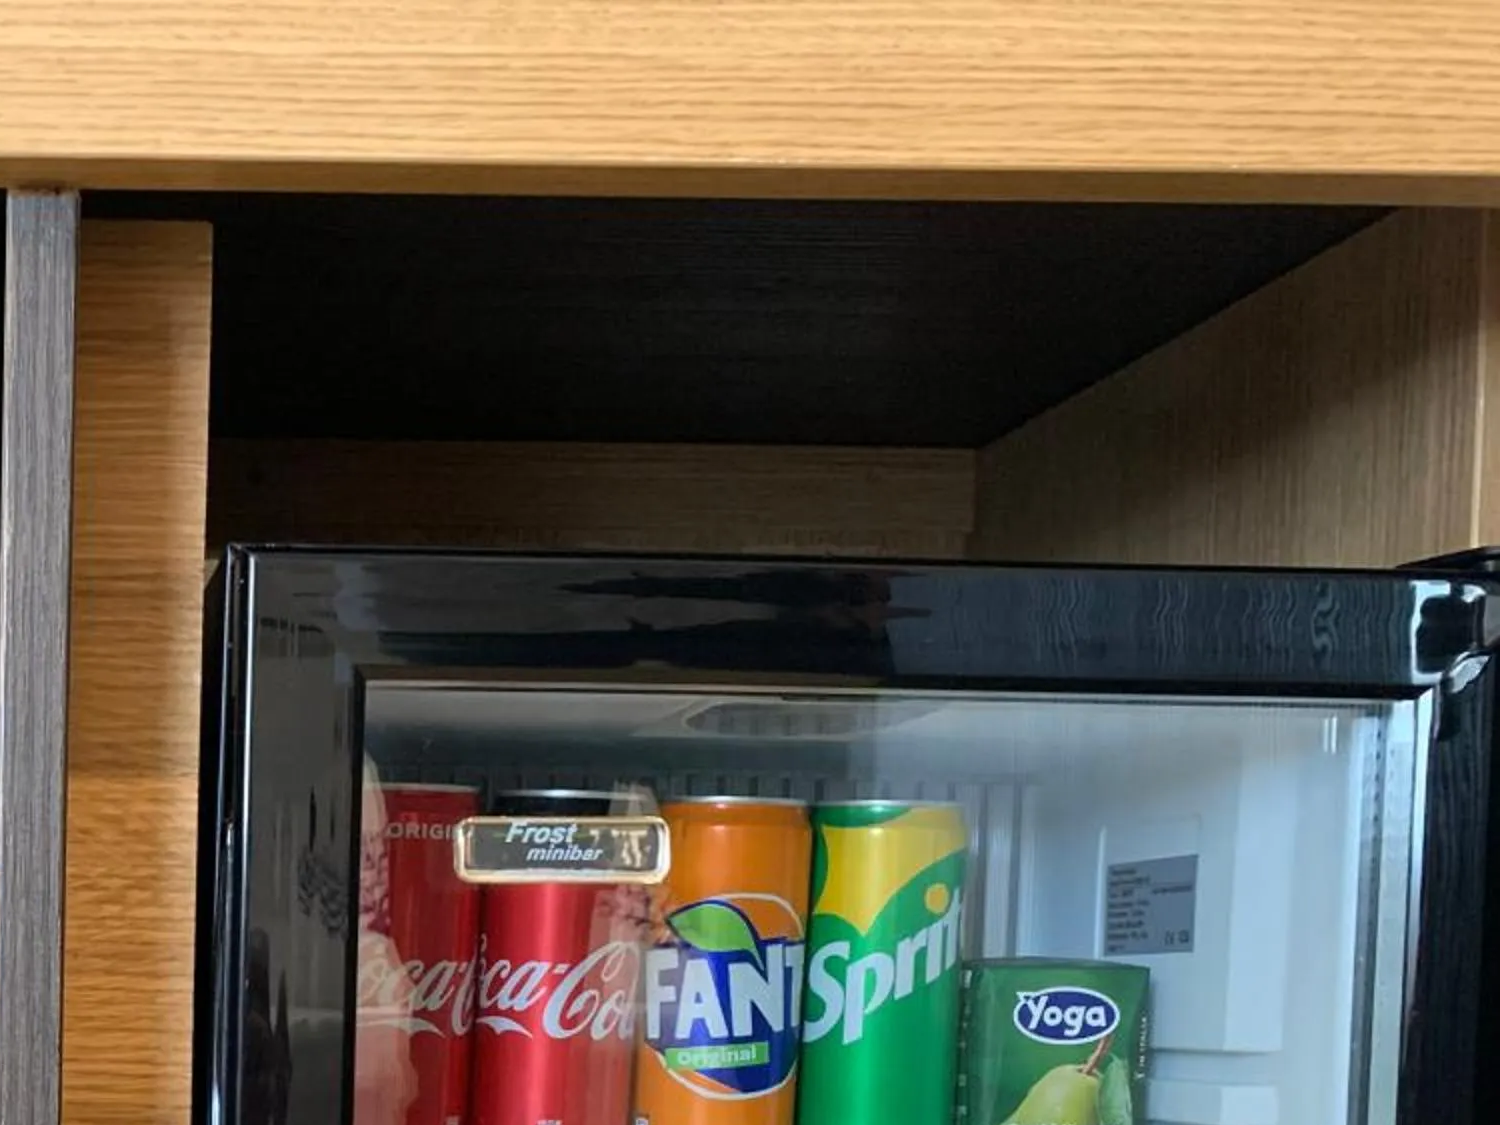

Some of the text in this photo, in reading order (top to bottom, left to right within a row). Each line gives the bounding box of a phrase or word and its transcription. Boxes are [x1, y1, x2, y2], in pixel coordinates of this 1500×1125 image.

[385, 821, 456, 839] ORIGI
[505, 820, 578, 844] Frost
[526, 843, 604, 862] minibar
[802, 887, 964, 1045] Sprit
[646, 943, 804, 1039] FANT
[1017, 991, 1107, 1037] Yoga
